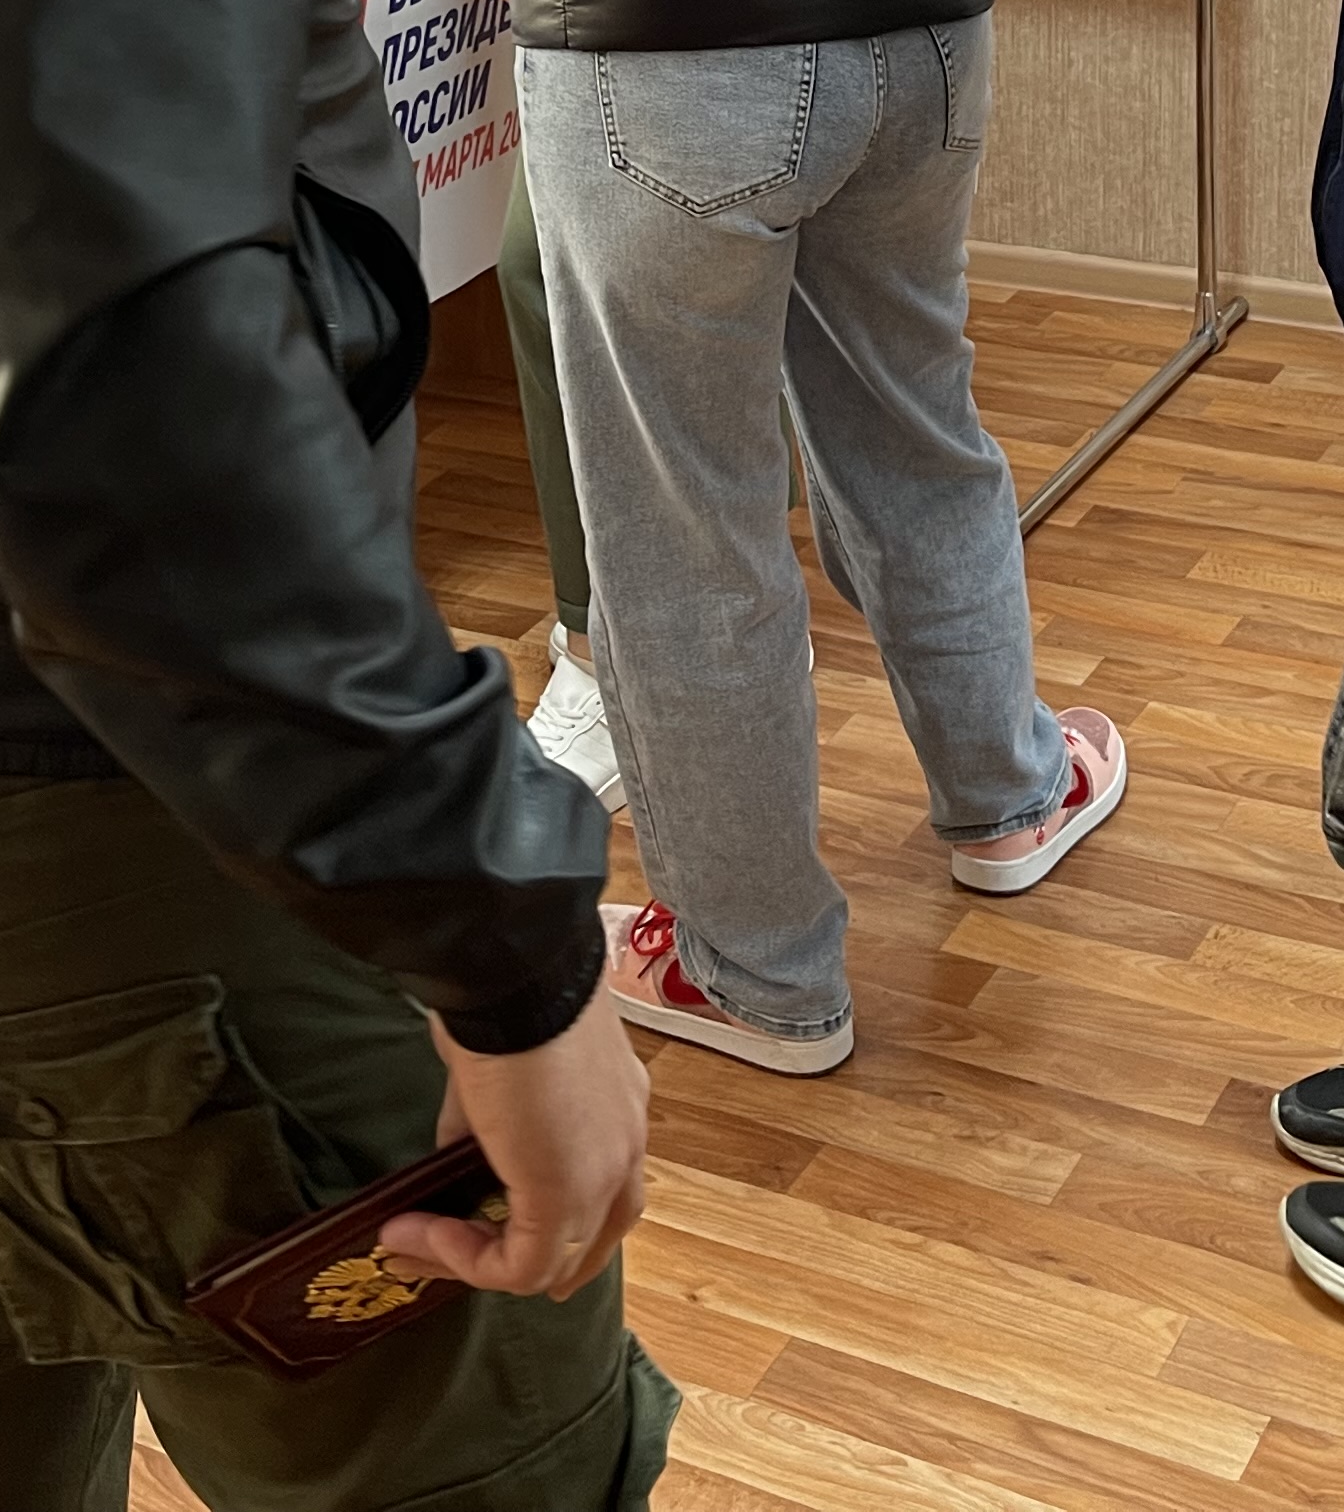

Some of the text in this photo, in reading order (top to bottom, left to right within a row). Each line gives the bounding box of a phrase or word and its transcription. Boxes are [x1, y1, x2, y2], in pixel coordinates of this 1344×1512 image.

[393, 58, 491, 144] ОССИИ
[420, 120, 496, 198] МАРТА
[498, 107, 521, 156] 20
